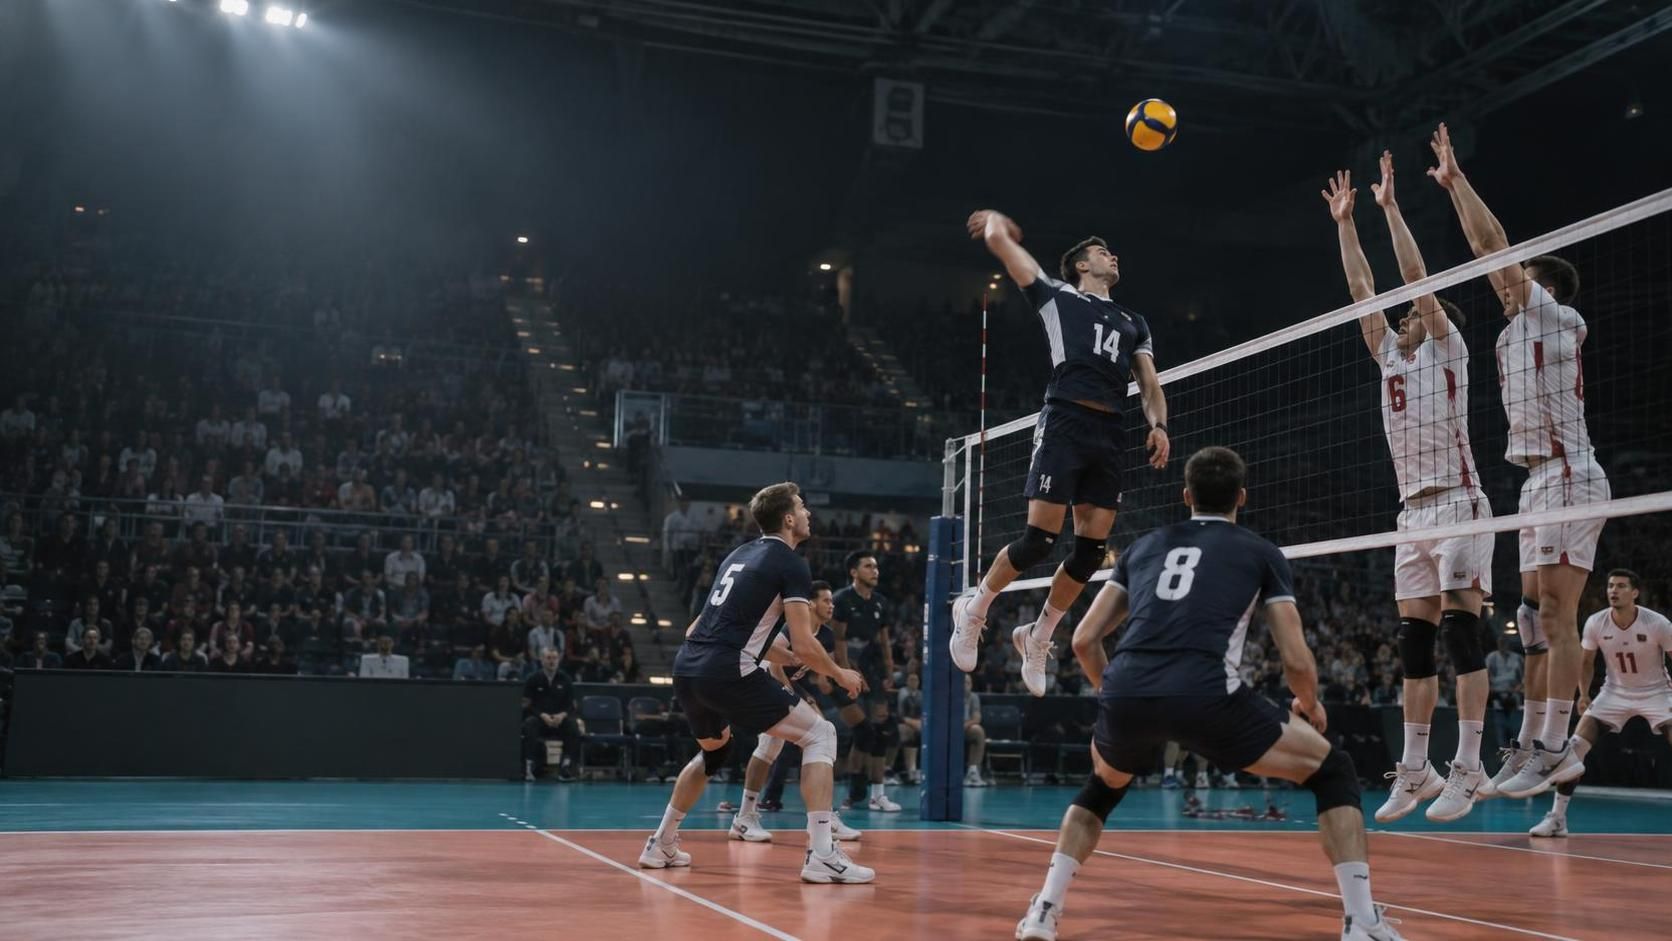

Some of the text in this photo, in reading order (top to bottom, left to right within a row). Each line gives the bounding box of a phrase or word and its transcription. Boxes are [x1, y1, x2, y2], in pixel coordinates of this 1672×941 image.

[1093, 322, 1121, 363] 14
[1388, 374, 1406, 412] 6
[1040, 473, 1052, 493] 14
[710, 563, 746, 606] 5
[1155, 546, 1202, 601] 8
[1616, 652, 1638, 673] 11
